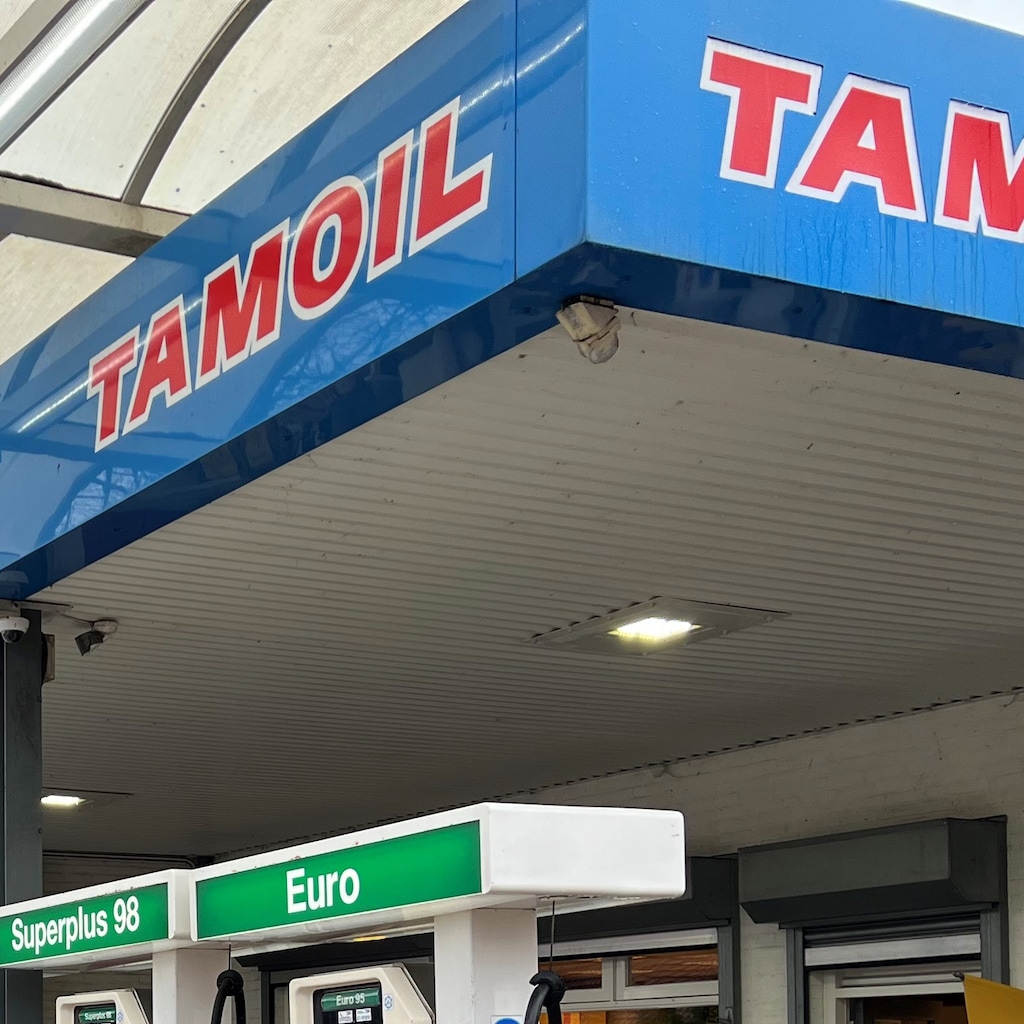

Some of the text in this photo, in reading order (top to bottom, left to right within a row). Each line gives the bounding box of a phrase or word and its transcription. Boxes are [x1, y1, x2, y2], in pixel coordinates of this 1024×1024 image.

[86, 96, 493, 453] TAMOIL
[285, 866, 361, 914] Euro
[11, 895, 140, 955] Superplus 98
[336, 993, 365, 1006] Euro 95
